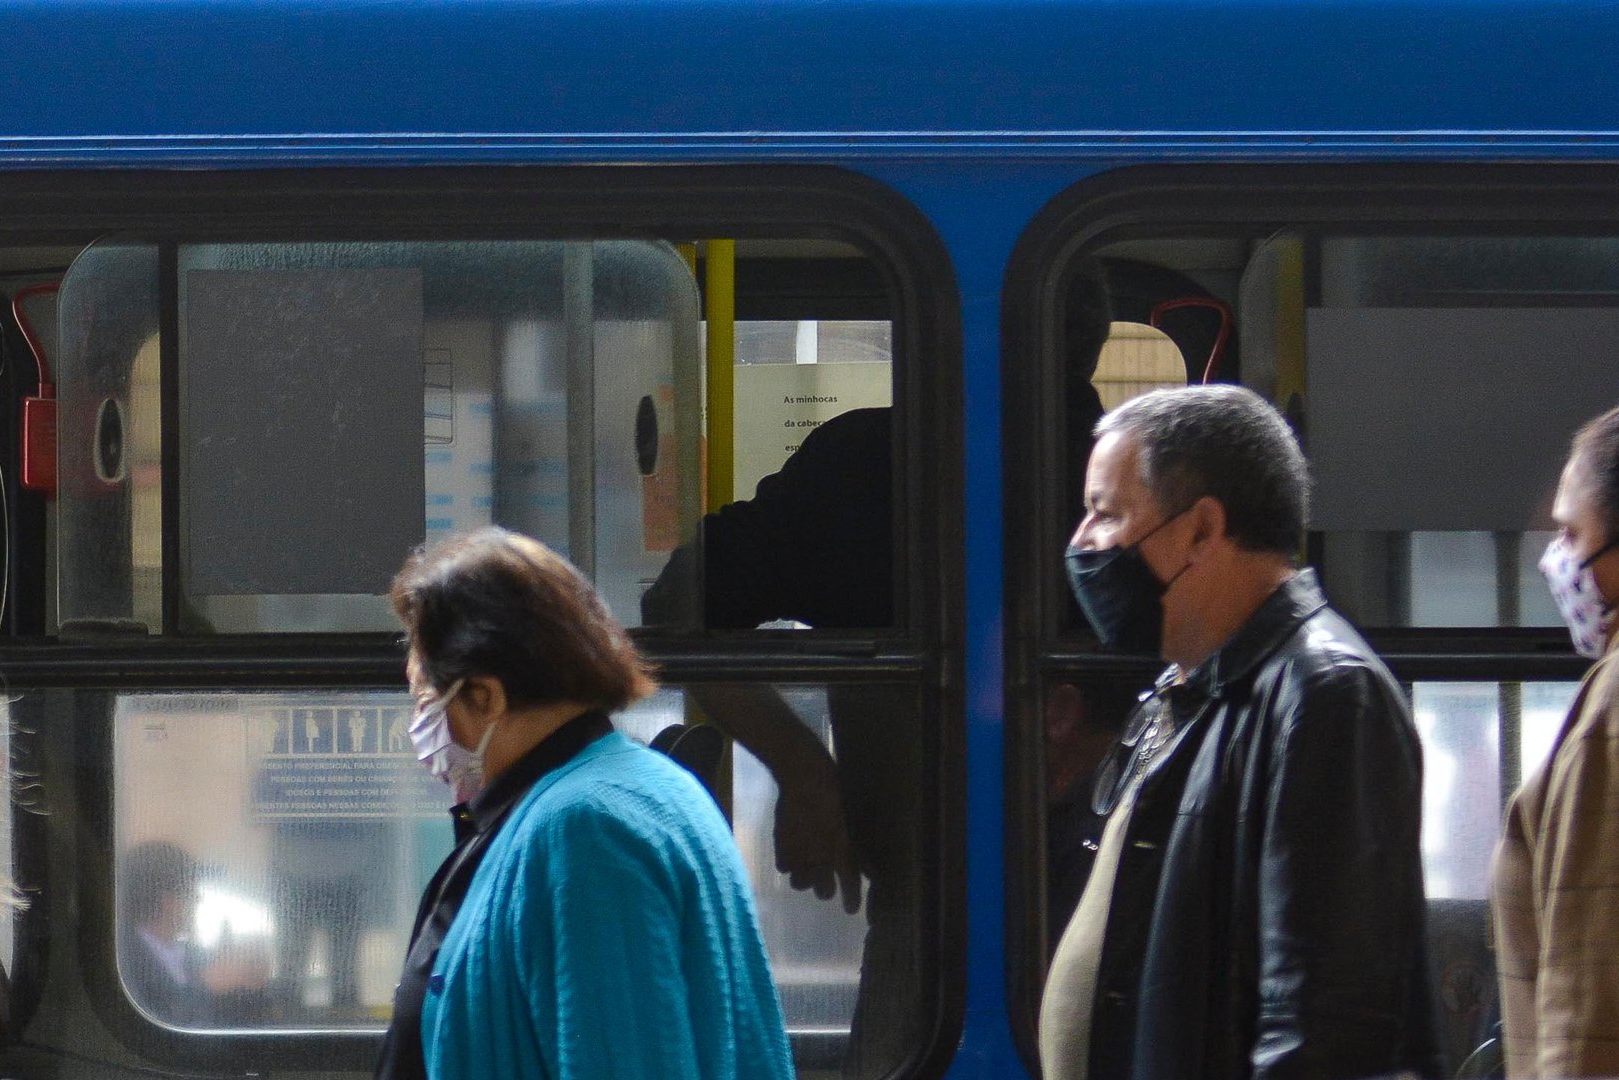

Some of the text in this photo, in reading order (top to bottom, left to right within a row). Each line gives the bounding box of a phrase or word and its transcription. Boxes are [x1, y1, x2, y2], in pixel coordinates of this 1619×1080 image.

[784, 395, 838, 404] As minhocas
[784, 420, 795, 428] da
